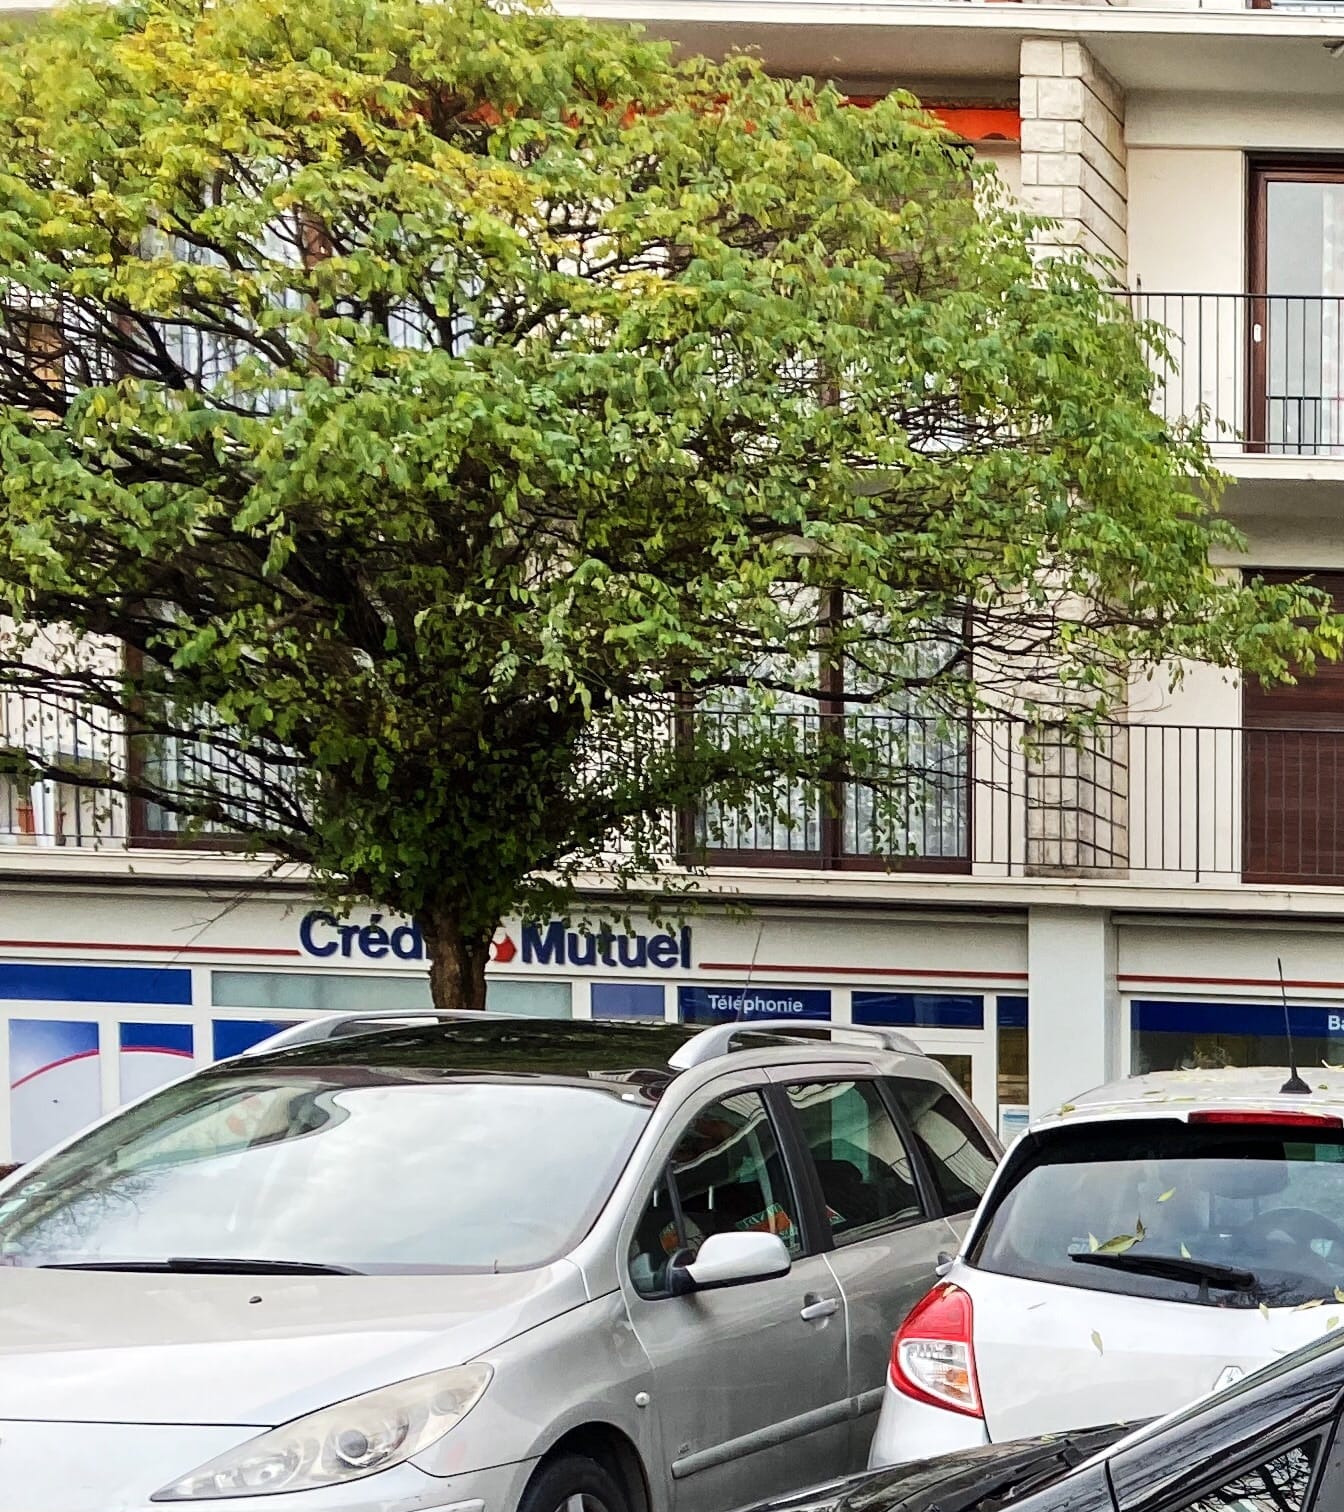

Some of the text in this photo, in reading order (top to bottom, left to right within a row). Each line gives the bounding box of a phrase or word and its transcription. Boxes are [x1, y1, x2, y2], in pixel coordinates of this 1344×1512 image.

[300, 909, 692, 969] Créd Mutuel
[707, 994, 804, 1014] Téléphonie
